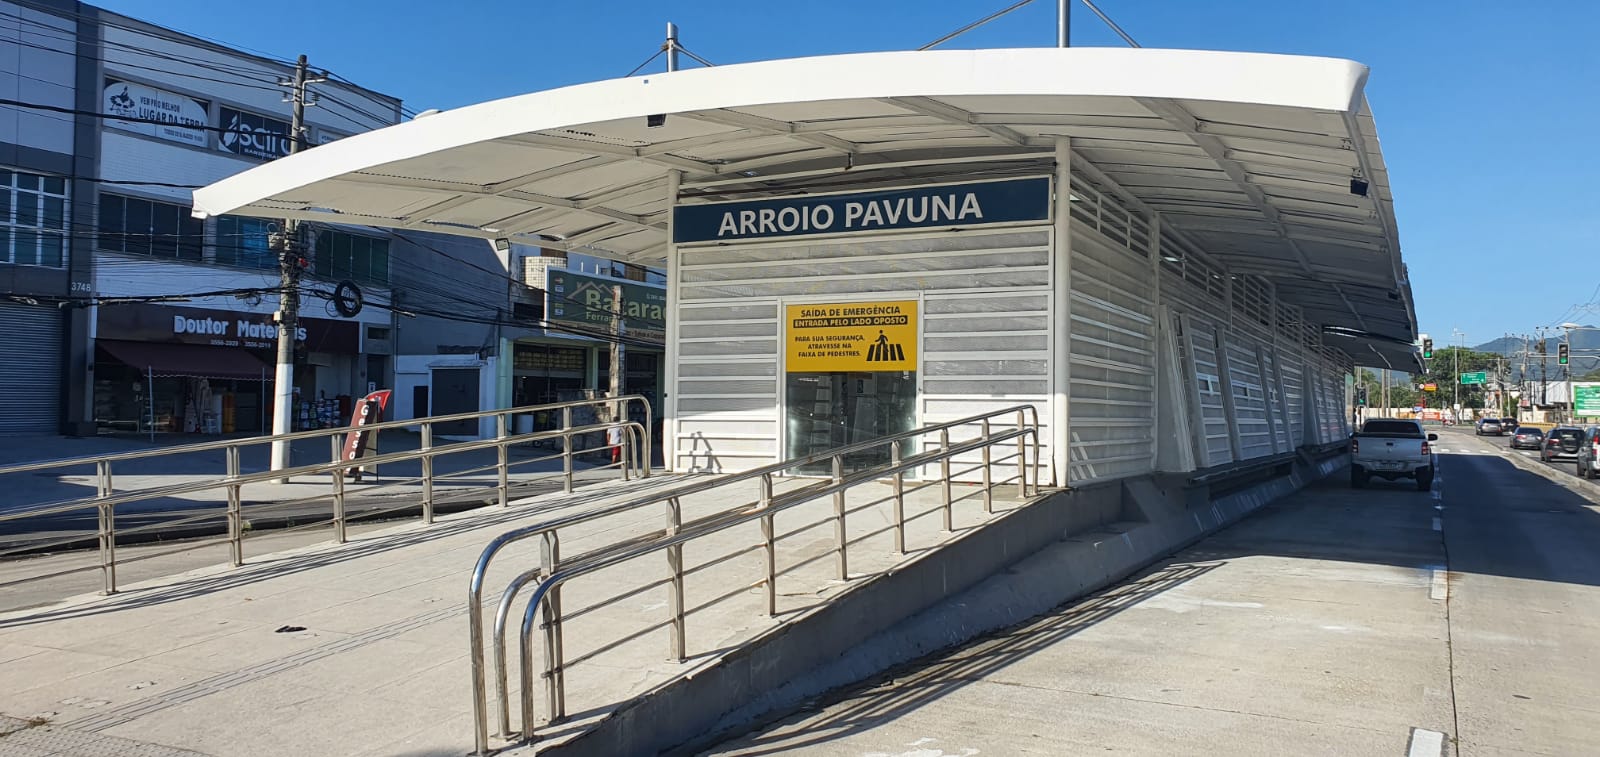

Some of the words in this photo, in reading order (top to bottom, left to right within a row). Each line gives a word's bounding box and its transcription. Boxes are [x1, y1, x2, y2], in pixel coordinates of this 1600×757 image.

[140, 96, 150, 105] VEM
[162, 101, 180, 112] MELHOR
[139, 107, 166, 123] LUGAR
[168, 114, 178, 125] DA
[718, 204, 834, 236] ARROIO
[845, 193, 983, 228] PAVUNA
[801, 307, 826, 318] SAÍDA
[829, 309, 840, 317] DE
[843, 305, 900, 316] EMERGÊNCIA
[173, 315, 229, 335] Doutor
[237, 319, 307, 341] Materis
[795, 319, 828, 327] ENTRADA
[830, 318, 849, 326] PELO
[851, 317, 871, 326] LADO
[874, 316, 906, 325] OPOSTO
[346, 404, 370, 460] Gesso
